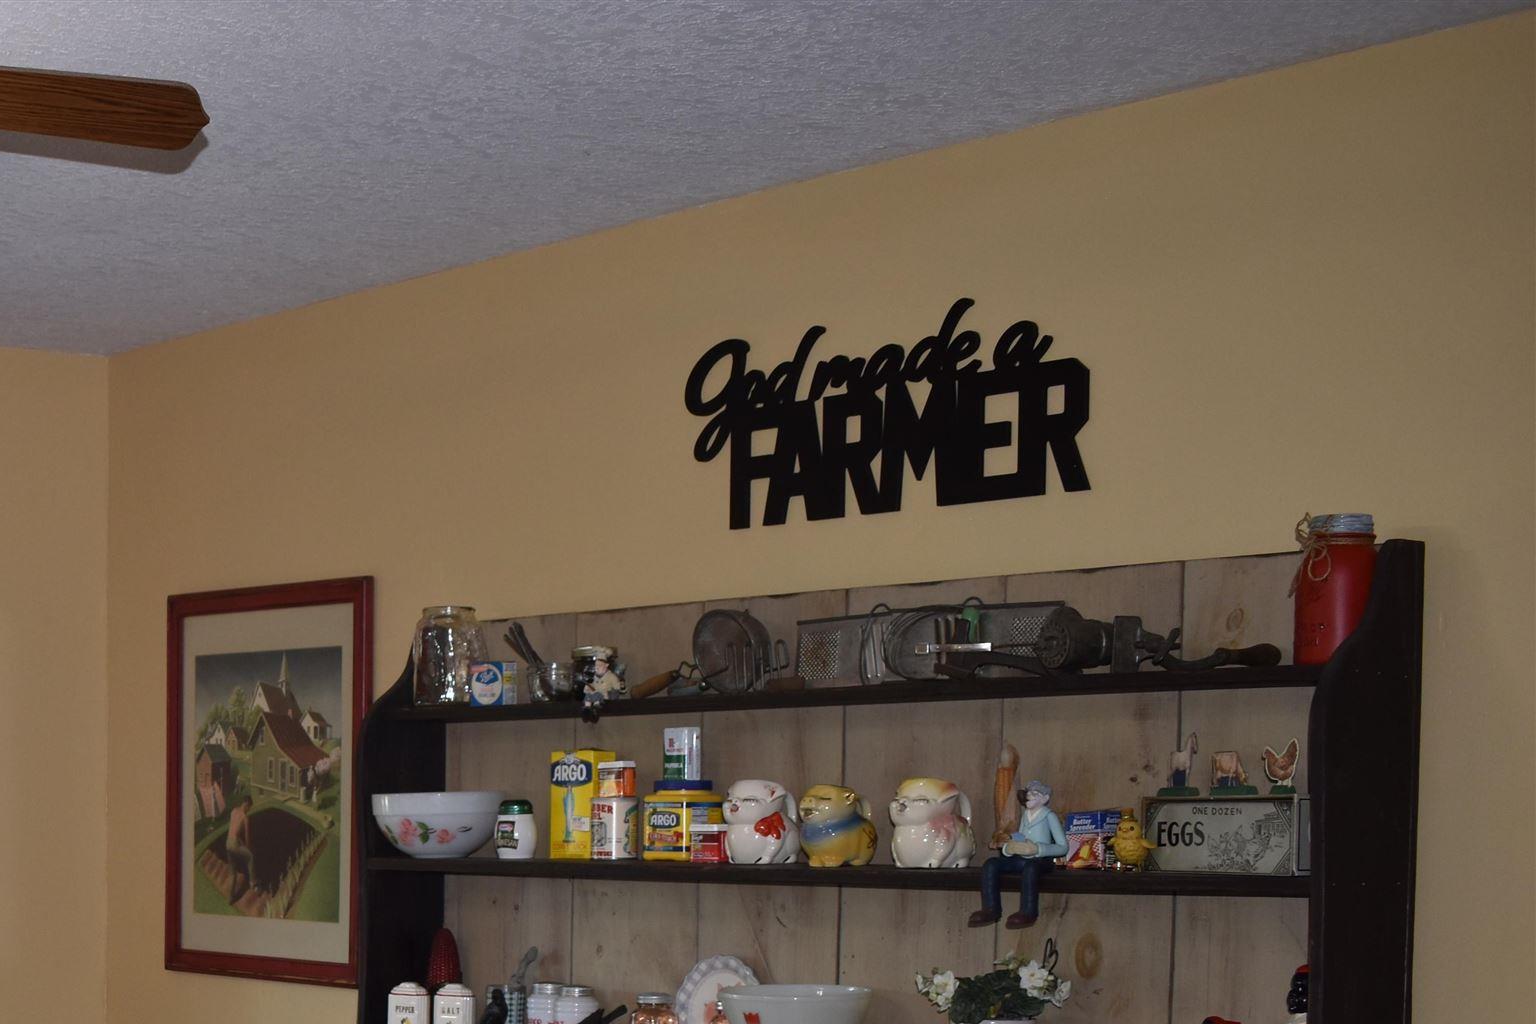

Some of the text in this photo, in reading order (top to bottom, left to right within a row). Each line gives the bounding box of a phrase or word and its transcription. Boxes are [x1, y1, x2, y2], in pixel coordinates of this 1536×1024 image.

[685, 297, 1054, 462] God made a
[730, 357, 1091, 530] FARMER
[552, 763, 587, 782] ARGO
[650, 814, 677, 826] ARGO
[1192, 806, 1243, 816] ONE DOZEN
[1157, 821, 1206, 848] EGGS
[395, 1005, 415, 1014] PEPPER
